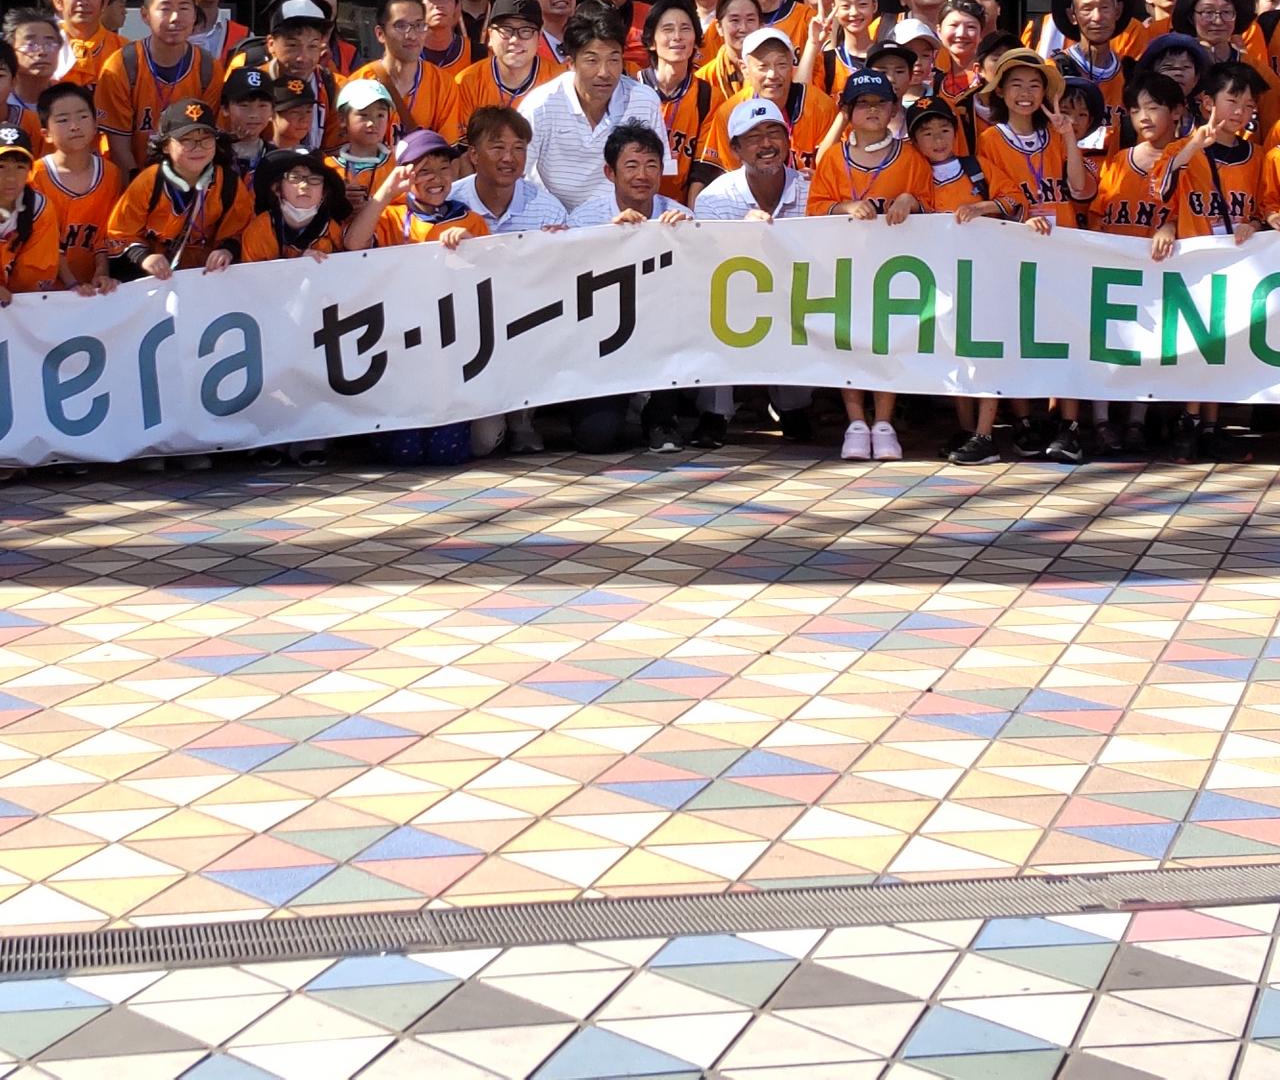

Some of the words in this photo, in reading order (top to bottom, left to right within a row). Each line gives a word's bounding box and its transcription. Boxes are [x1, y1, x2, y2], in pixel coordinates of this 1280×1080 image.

[852, 75, 882, 87] TOKYO
[312, 250, 674, 396] セ・リーグ
